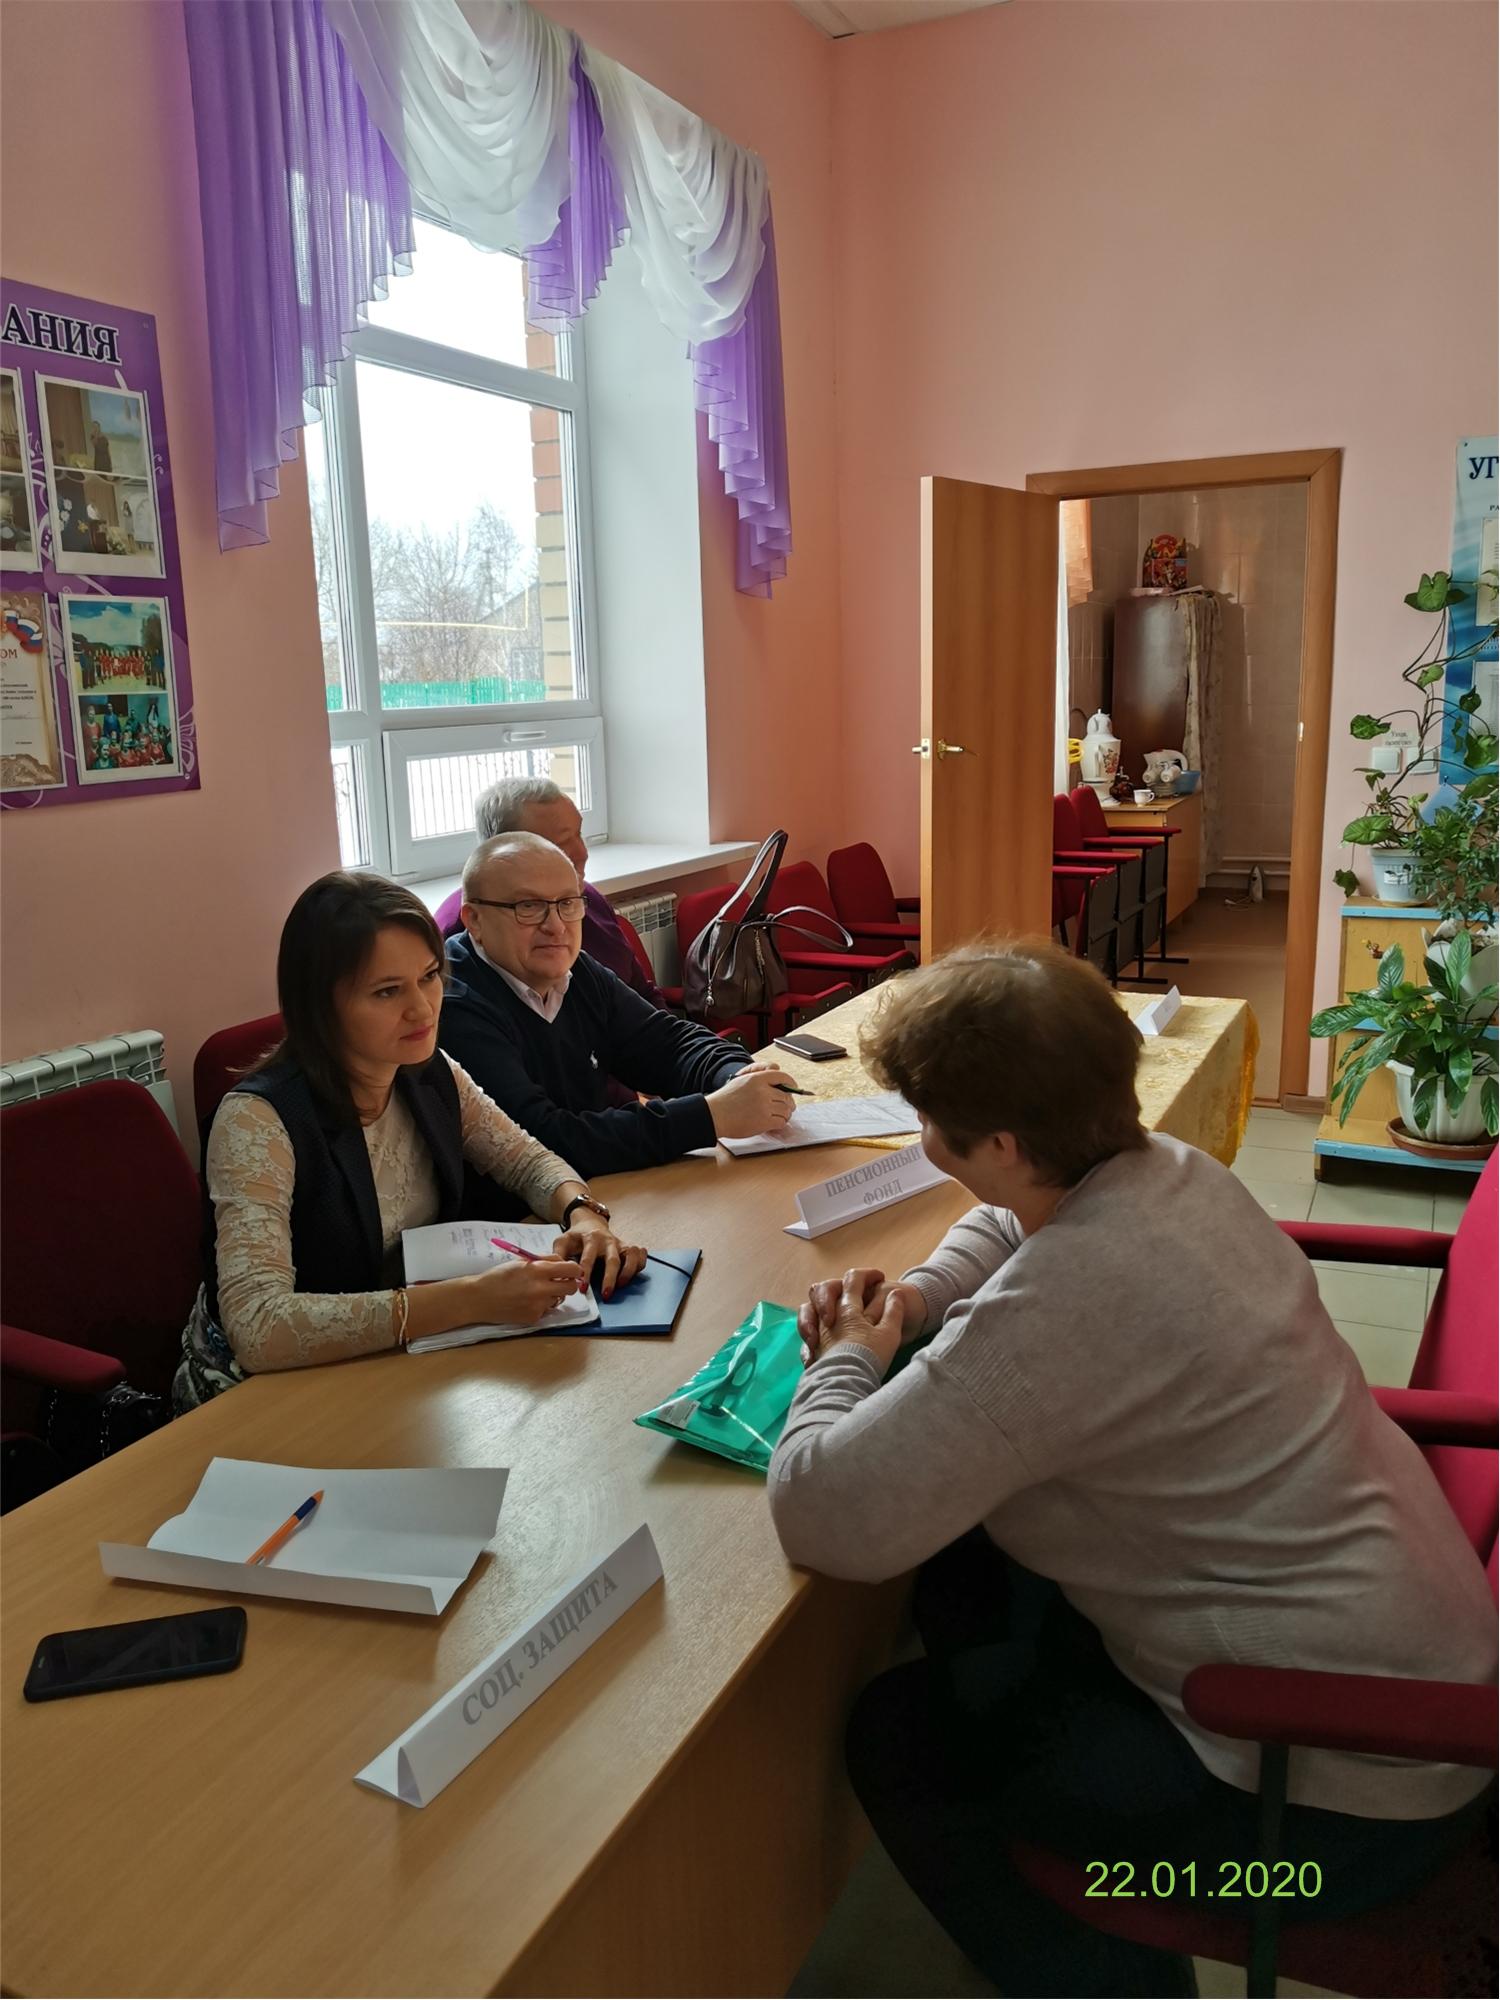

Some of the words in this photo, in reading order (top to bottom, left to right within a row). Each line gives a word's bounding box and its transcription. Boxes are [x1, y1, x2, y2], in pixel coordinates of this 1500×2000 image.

[0, 304, 122, 365] АНИЯ
[863, 1179, 903, 1206] ФОНД
[461, 1656, 525, 1726] СОЦ.
[522, 1570, 619, 1670] ЗАЩИТА
